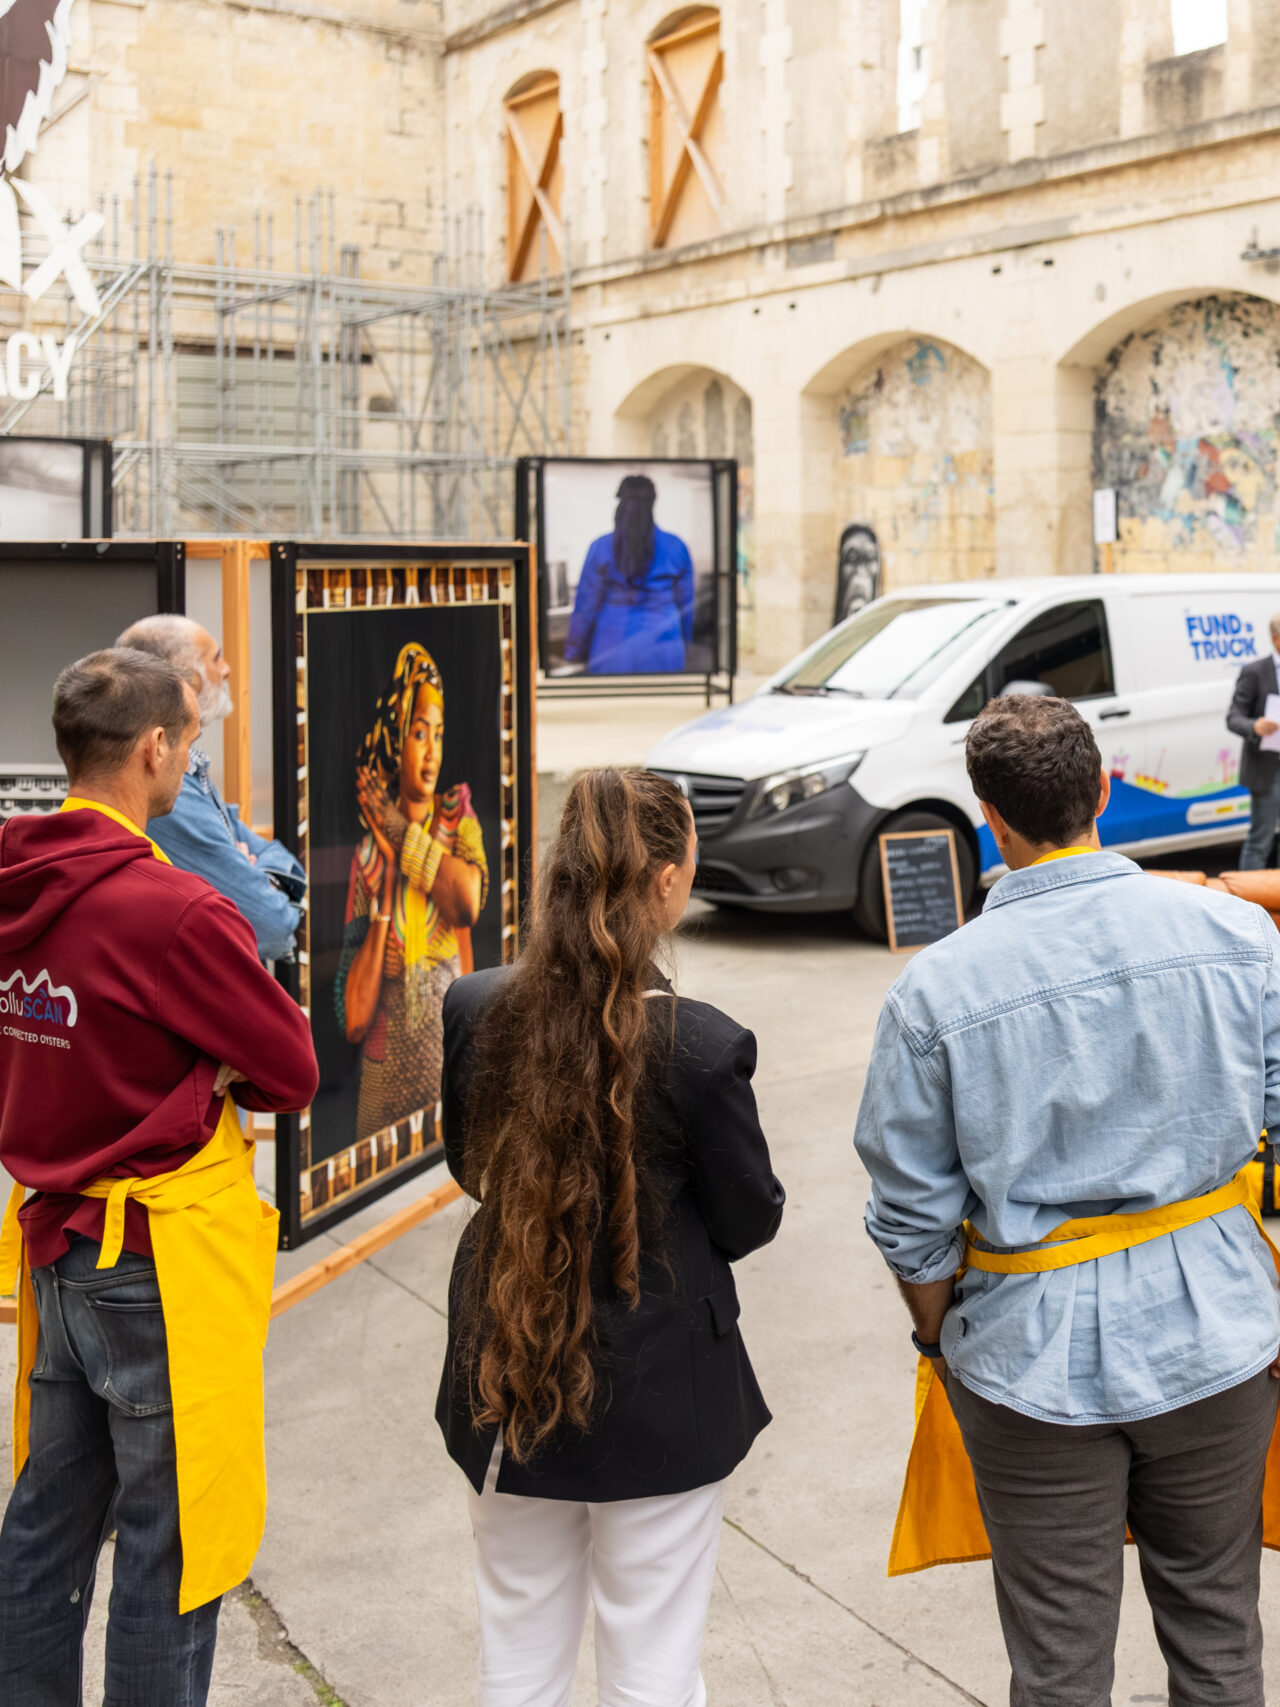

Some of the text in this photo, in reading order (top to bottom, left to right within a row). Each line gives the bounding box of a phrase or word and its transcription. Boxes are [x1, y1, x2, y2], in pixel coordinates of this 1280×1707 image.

[1186, 614, 1241, 638] FUND
[1190, 637, 1257, 660] TRUCK
[40, 1034, 70, 1049] OYSTERS
